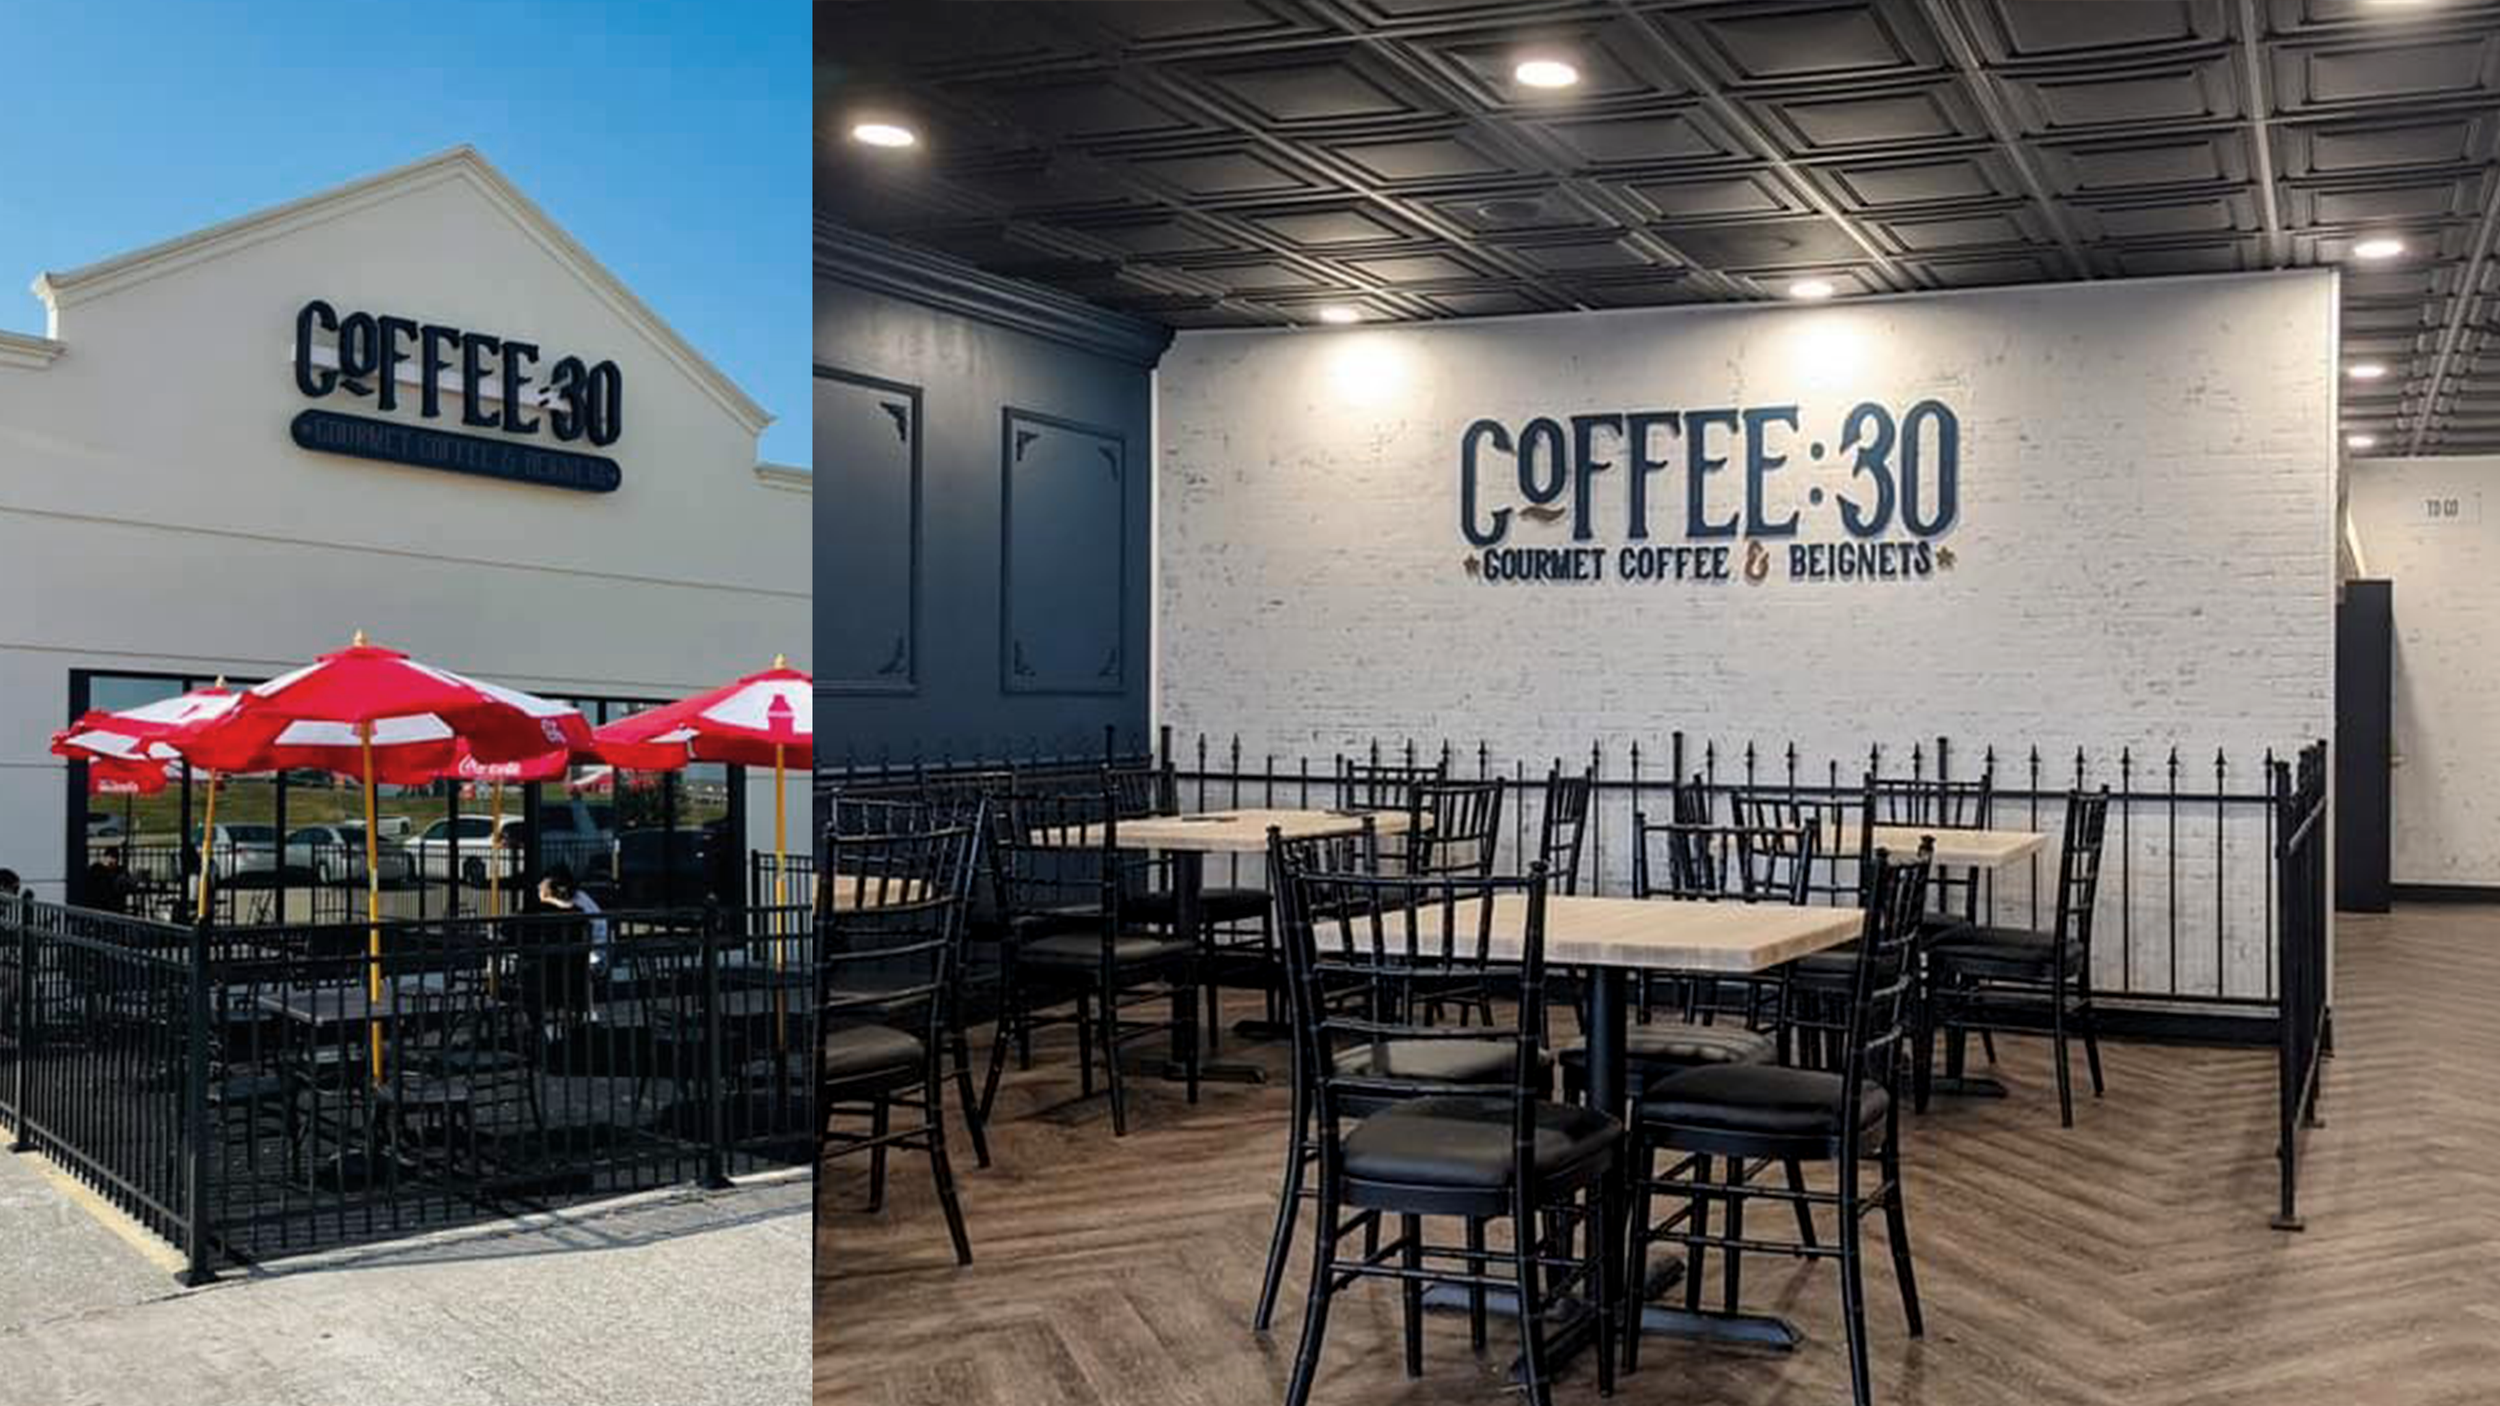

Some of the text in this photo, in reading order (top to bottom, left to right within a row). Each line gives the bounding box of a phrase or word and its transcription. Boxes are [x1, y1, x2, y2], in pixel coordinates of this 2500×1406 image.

[1483, 540, 1932, 586] GOURMET COFFEE & BEIGNETS
